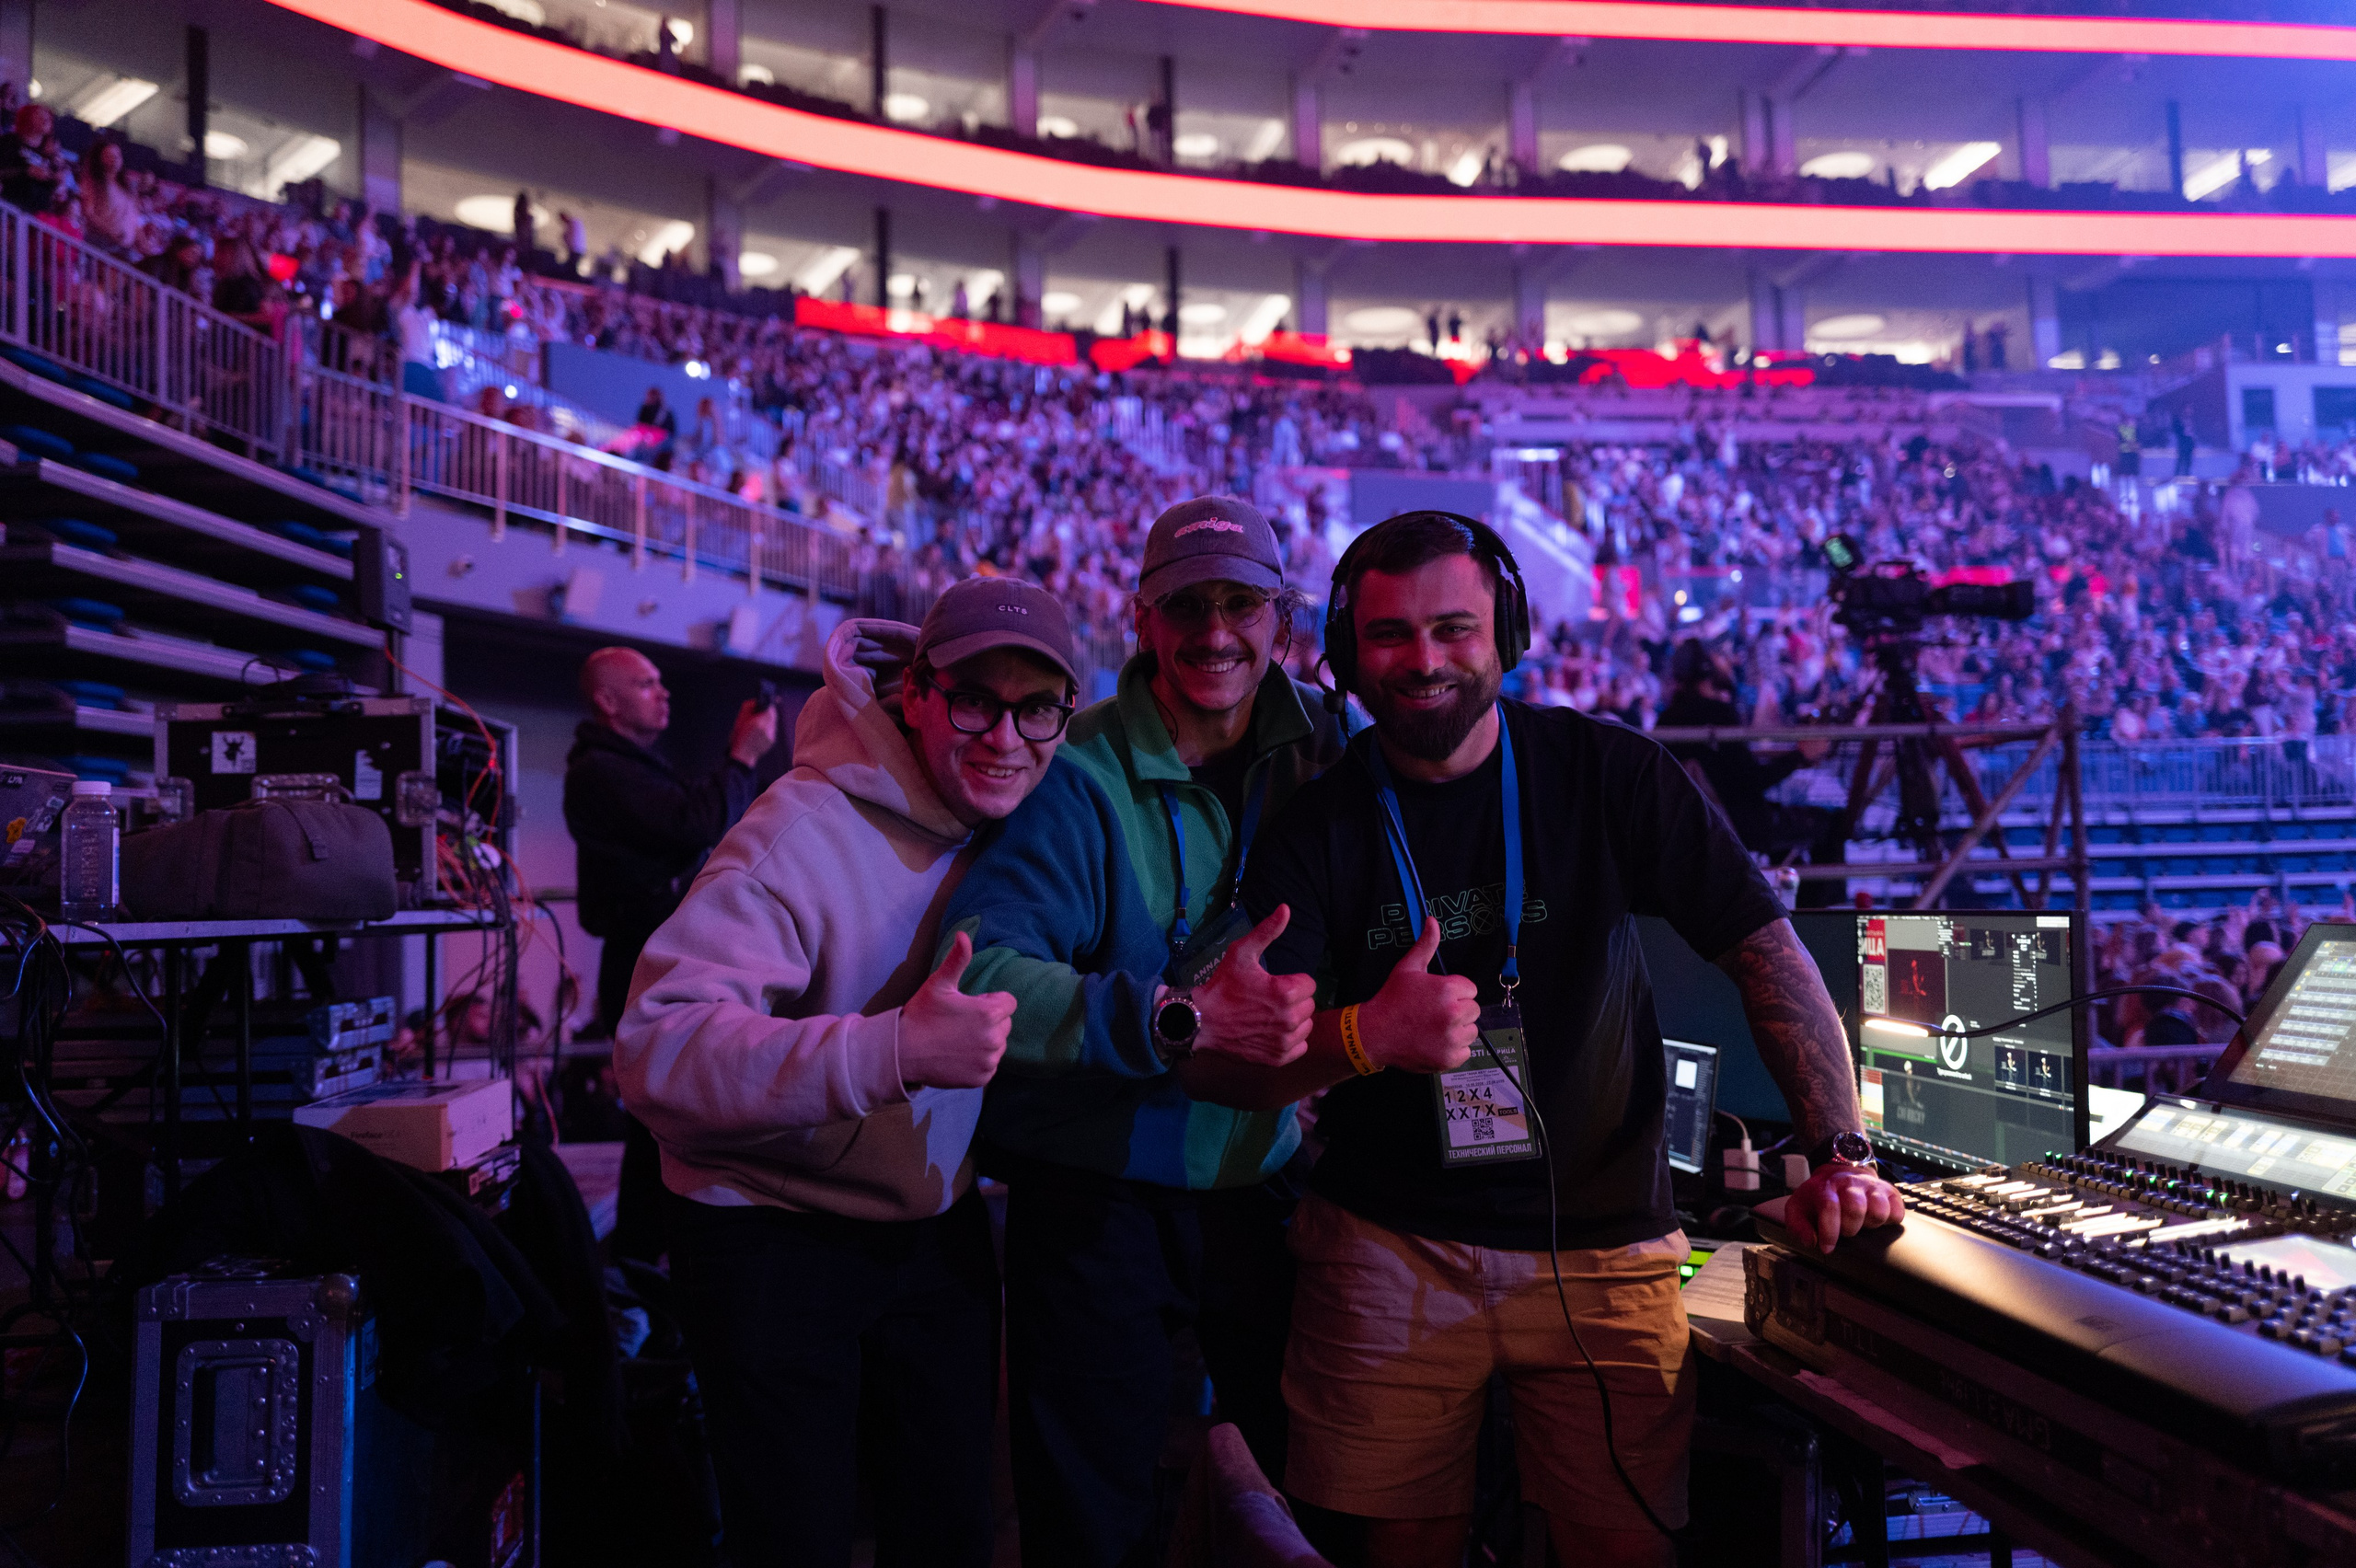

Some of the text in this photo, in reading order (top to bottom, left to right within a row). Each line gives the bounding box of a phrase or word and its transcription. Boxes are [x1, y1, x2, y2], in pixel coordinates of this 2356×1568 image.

[1174, 516, 1243, 537] amiga
[998, 605, 1028, 615] CLTS
[1194, 957, 1220, 982] ANNA
[1345, 1012, 1353, 1031] ASTI
[1346, 1032, 1361, 1059] ANNA
[1471, 1049, 1484, 1057] STI
[1448, 1143, 1532, 1159] ТЕХНИЧЕСКИЙ ПЕРСОНАЛ
